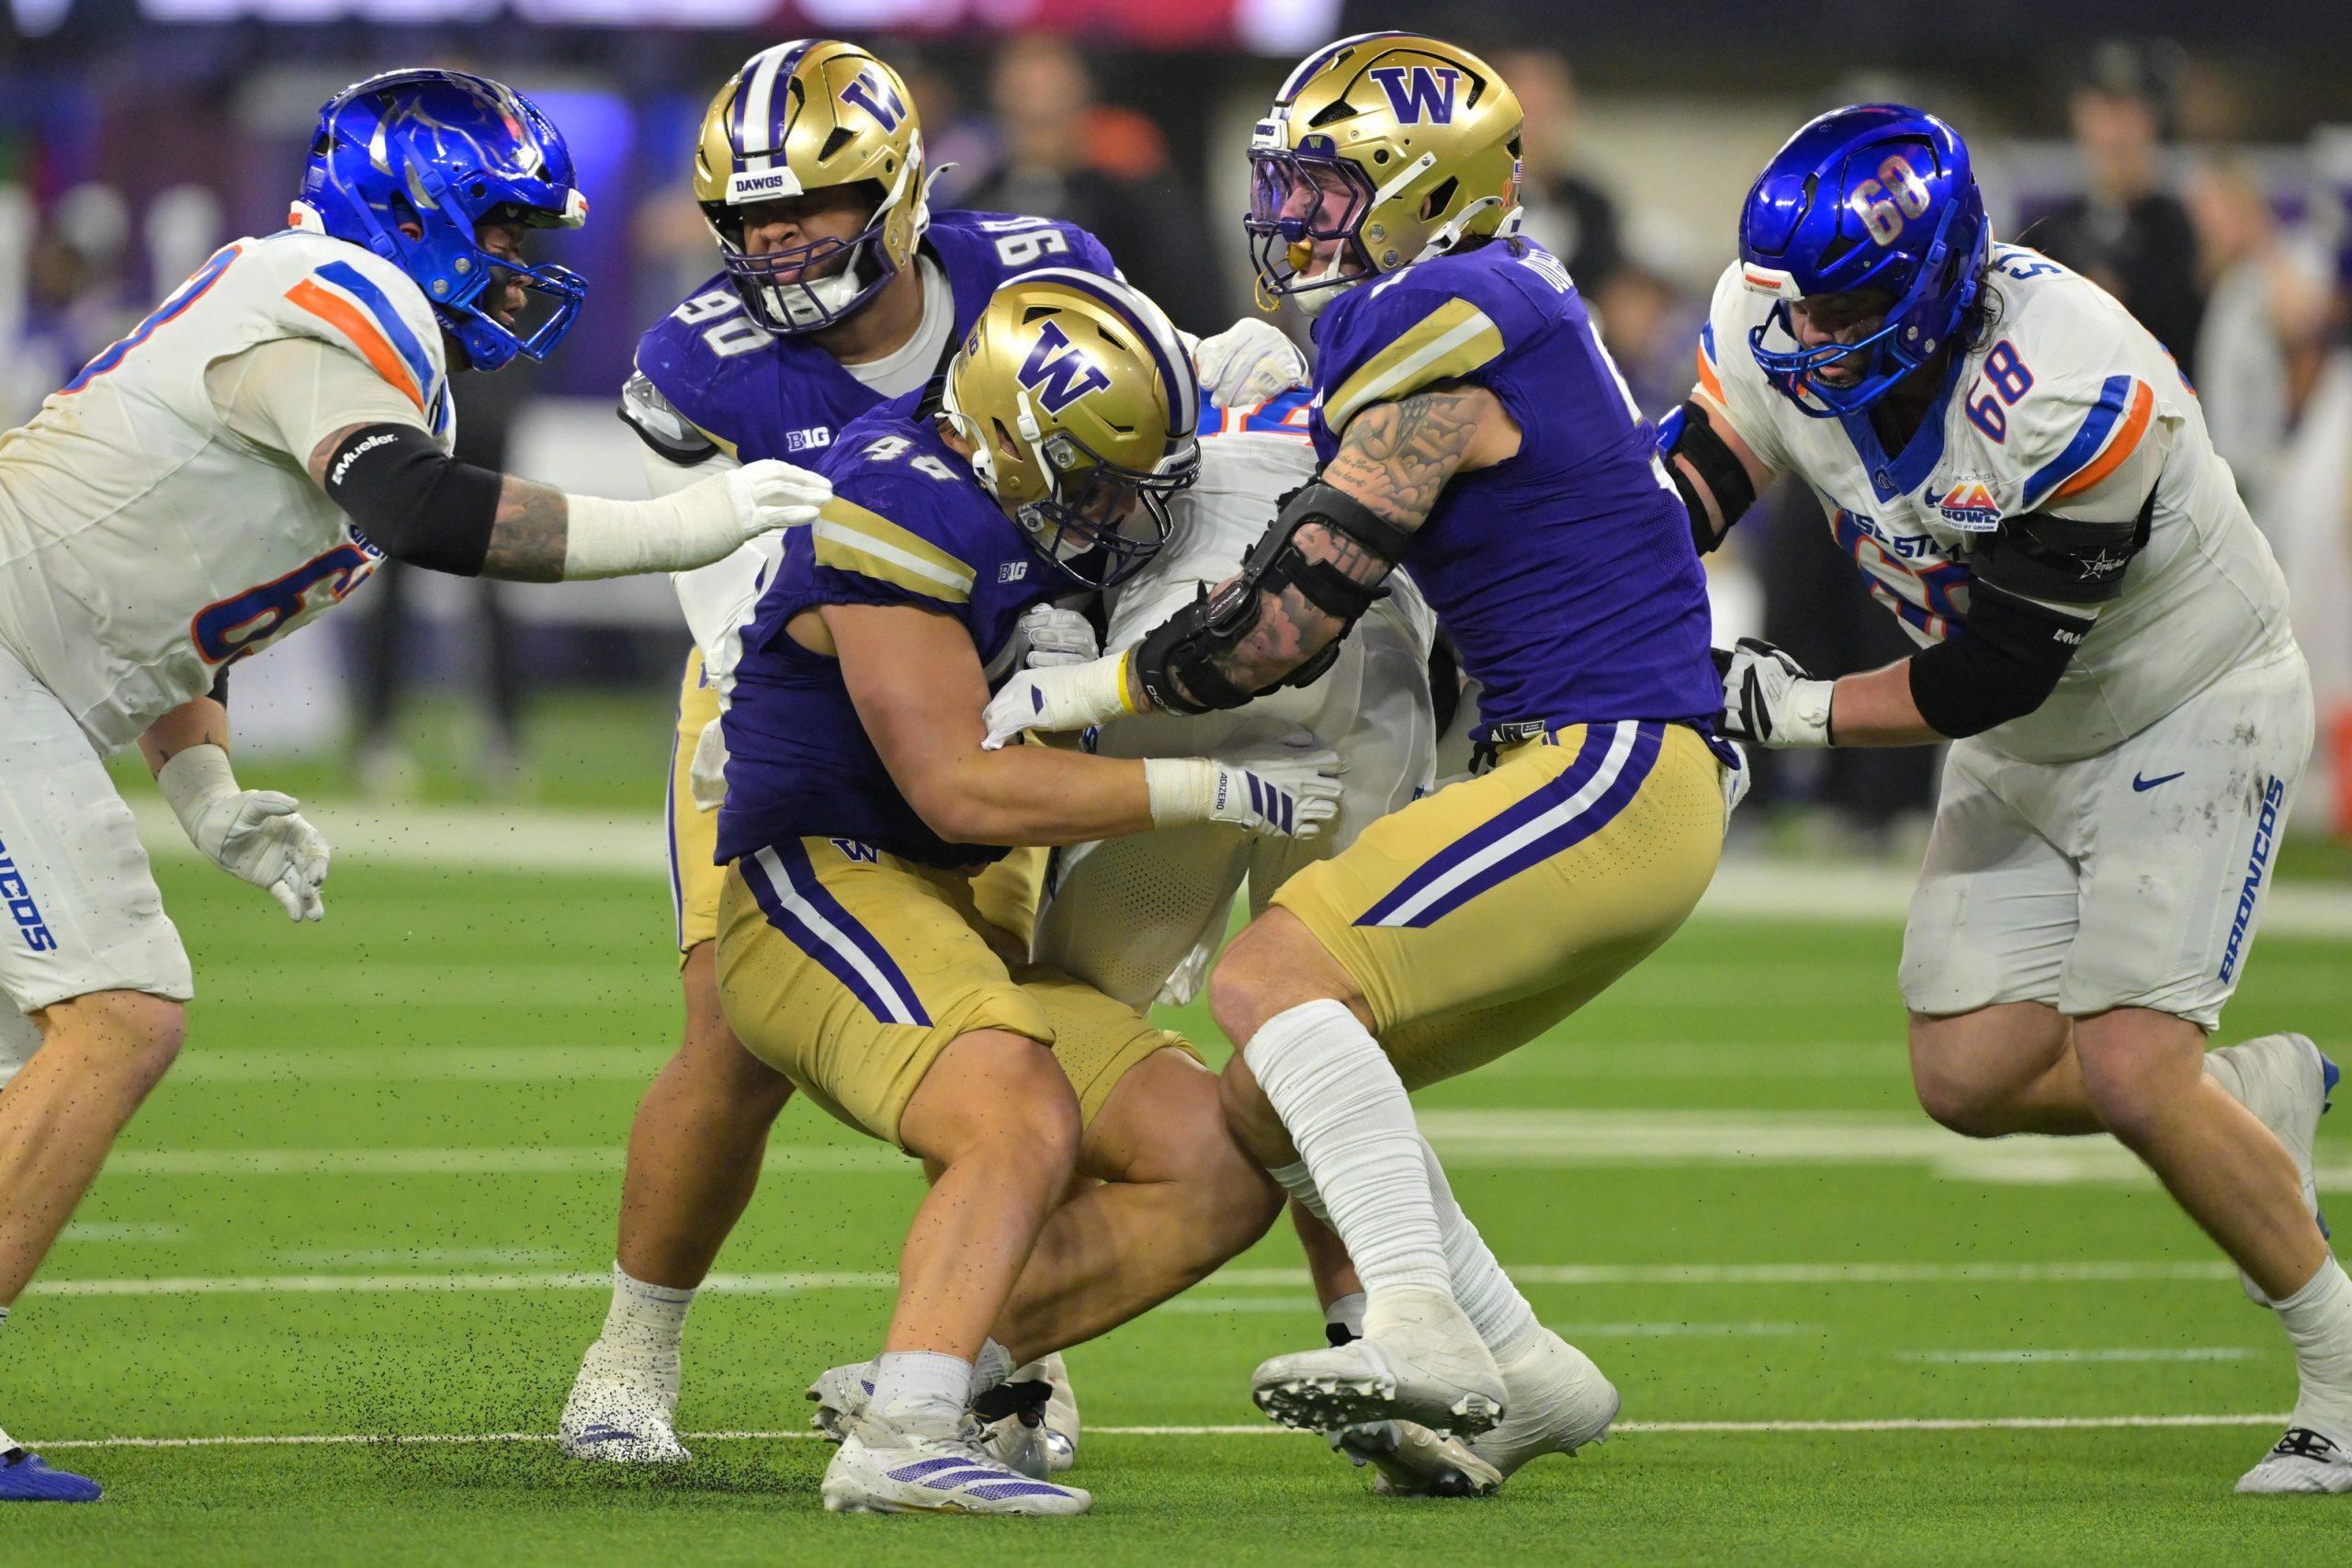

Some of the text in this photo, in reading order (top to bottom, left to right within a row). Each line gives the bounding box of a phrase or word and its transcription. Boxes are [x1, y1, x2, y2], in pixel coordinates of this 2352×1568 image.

[839, 62, 908, 137] W
[1368, 66, 1463, 126] W
[1308, 136, 1323, 148] W
[736, 175, 784, 192] DAWGS
[1850, 154, 1931, 247] 68
[670, 290, 776, 358] 90
[1015, 319, 1113, 416] W
[1964, 339, 2034, 445] 68
[1940, 484, 1997, 509] LA
[1940, 509, 1996, 524] BOWL
[190, 544, 375, 666] 6
[1216, 771, 1227, 810] ADIZERO
[2217, 774, 2284, 986] BRONCOS
